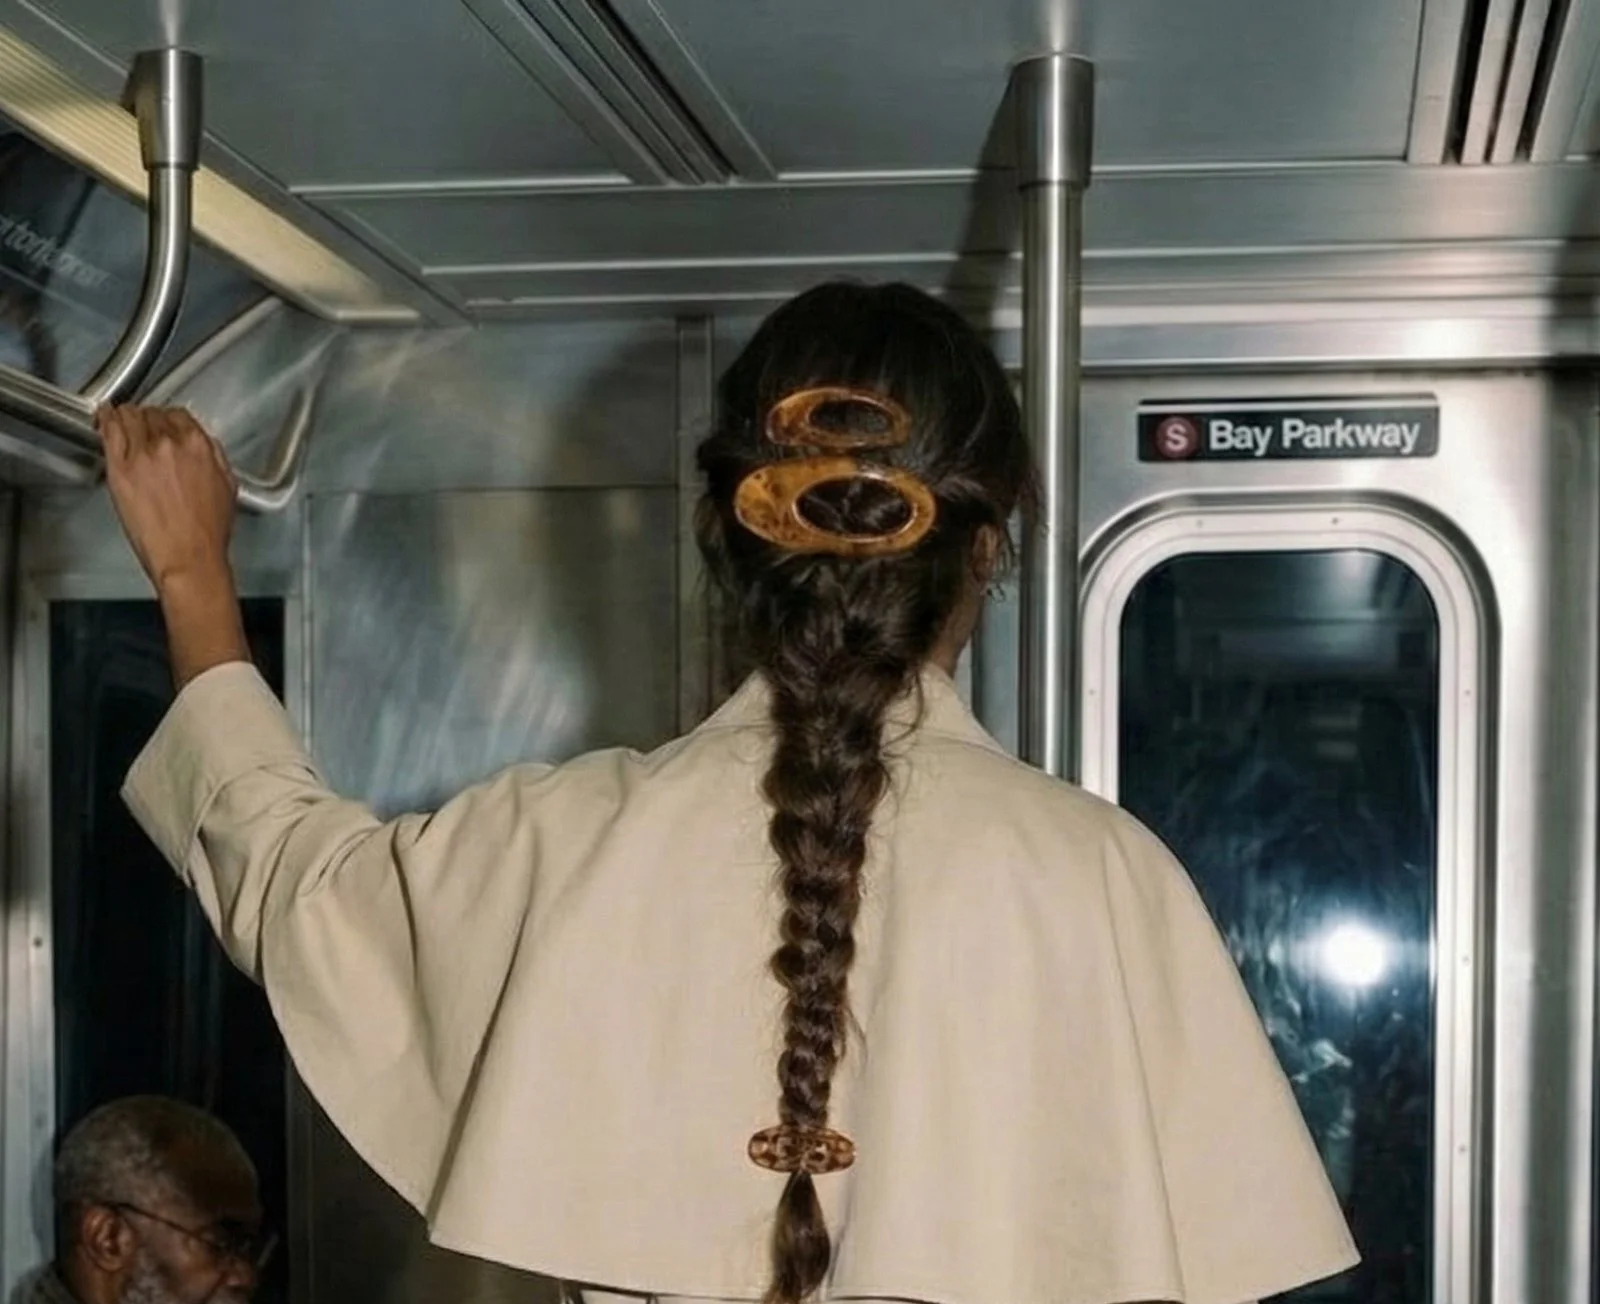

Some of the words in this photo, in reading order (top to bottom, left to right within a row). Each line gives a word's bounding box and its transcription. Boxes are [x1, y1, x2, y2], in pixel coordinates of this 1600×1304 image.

[1165, 423, 1188, 452] S
[1209, 420, 1273, 456] Bay
[1282, 418, 1420, 454] Parkway
